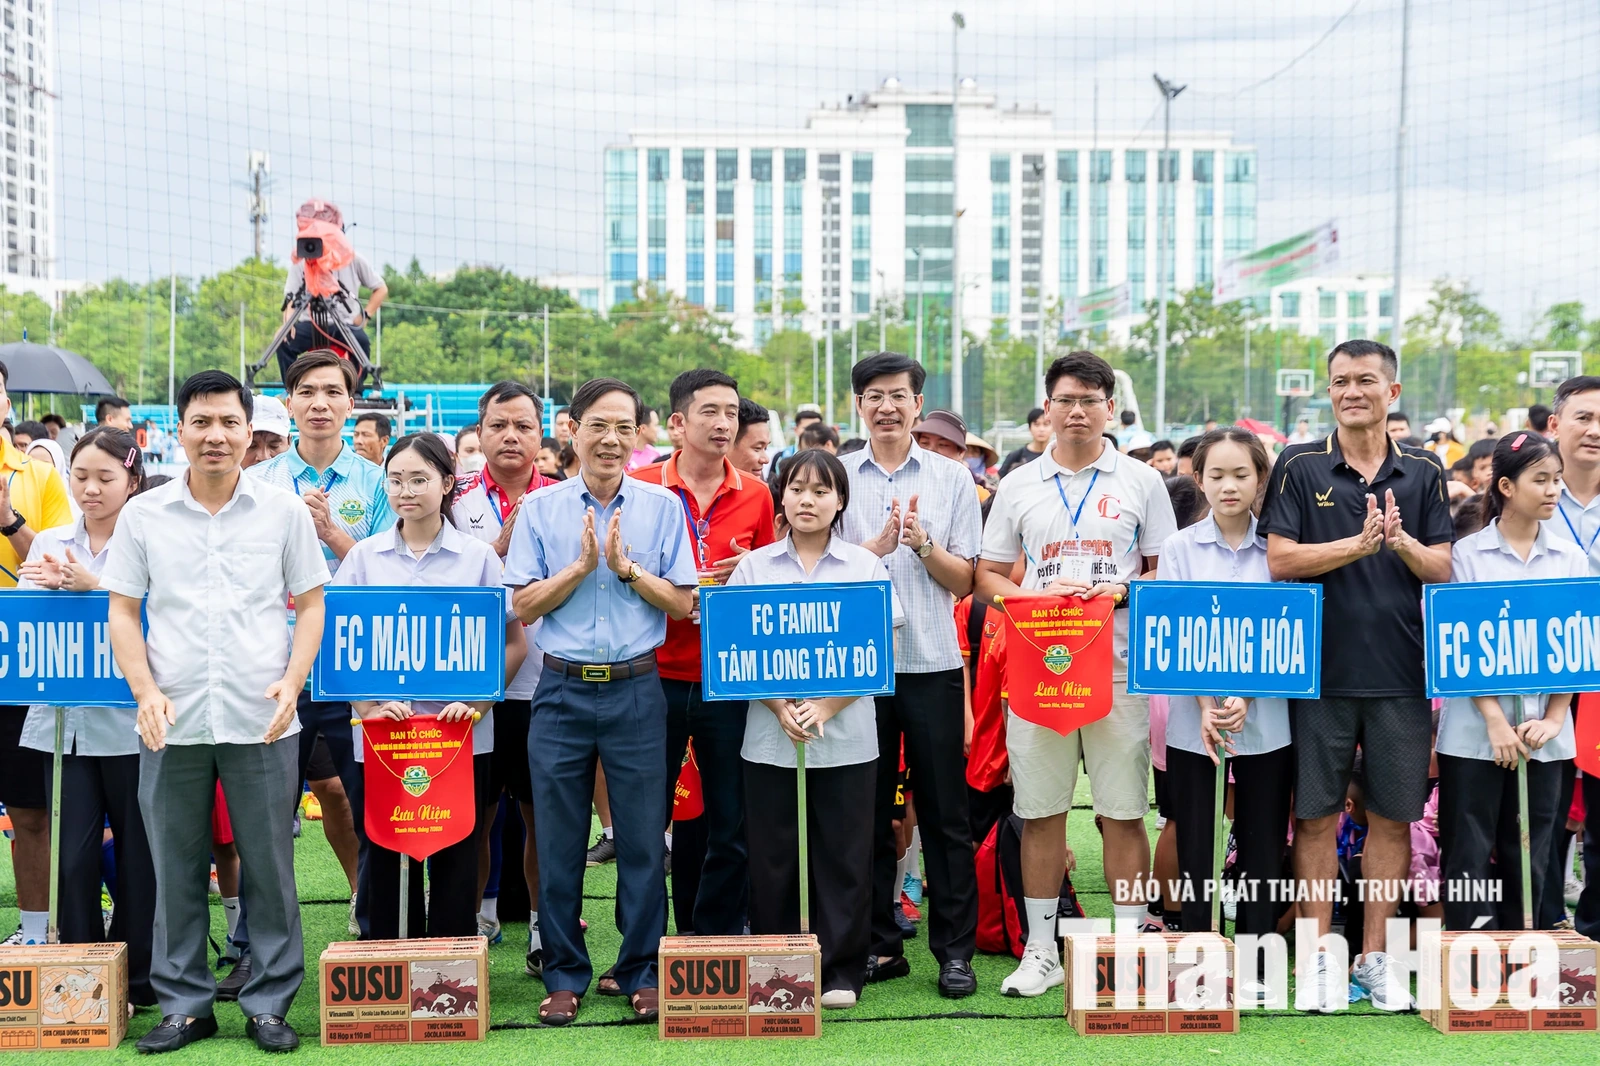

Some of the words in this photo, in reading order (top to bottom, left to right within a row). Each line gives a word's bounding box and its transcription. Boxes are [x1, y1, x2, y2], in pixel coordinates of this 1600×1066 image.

[751, 603, 773, 635] FC
[778, 601, 841, 634] FAMILY
[1031, 609, 1048, 618] BAN
[1049, 605, 1060, 617] TỔ
[1061, 606, 1084, 616] CHỨC
[335, 614, 363, 671] FC
[371, 602, 427, 685] MẬU
[434, 603, 486, 672] LÂM
[1144, 615, 1171, 672] FC
[1177, 594, 1254, 674] HOẰNG
[1260, 605, 1306, 675] HÓA
[1438, 621, 1470, 678] FC
[1478, 599, 1539, 677] SẦM
[1546, 610, 1600, 674] SƠN
[0, 621, 9, 679] C
[17, 621, 84, 691] ĐỊNH
[718, 643, 757, 682] TÂM
[763, 648, 810, 680] LONG
[815, 640, 848, 678] TÂY
[852, 638, 878, 677] ĐÔ
[1061, 680, 1092, 699] Niệm
[390, 732, 406, 740] BAN
[407, 727, 417, 739] TỔ
[419, 728, 442, 739] CHỨC
[417, 804, 451, 823] Niệm
[0, 970, 32, 1007] SU
[331, 965, 403, 1002] SUSU
[670, 960, 741, 996] SUSU
[1091, 956, 1161, 992] SUSU
[1454, 953, 1523, 990] SUSU
[667, 1004, 693, 1012] Vinamilk
[1112, 1022, 1121, 1030] 110
[1122, 1022, 1129, 1030] ml
